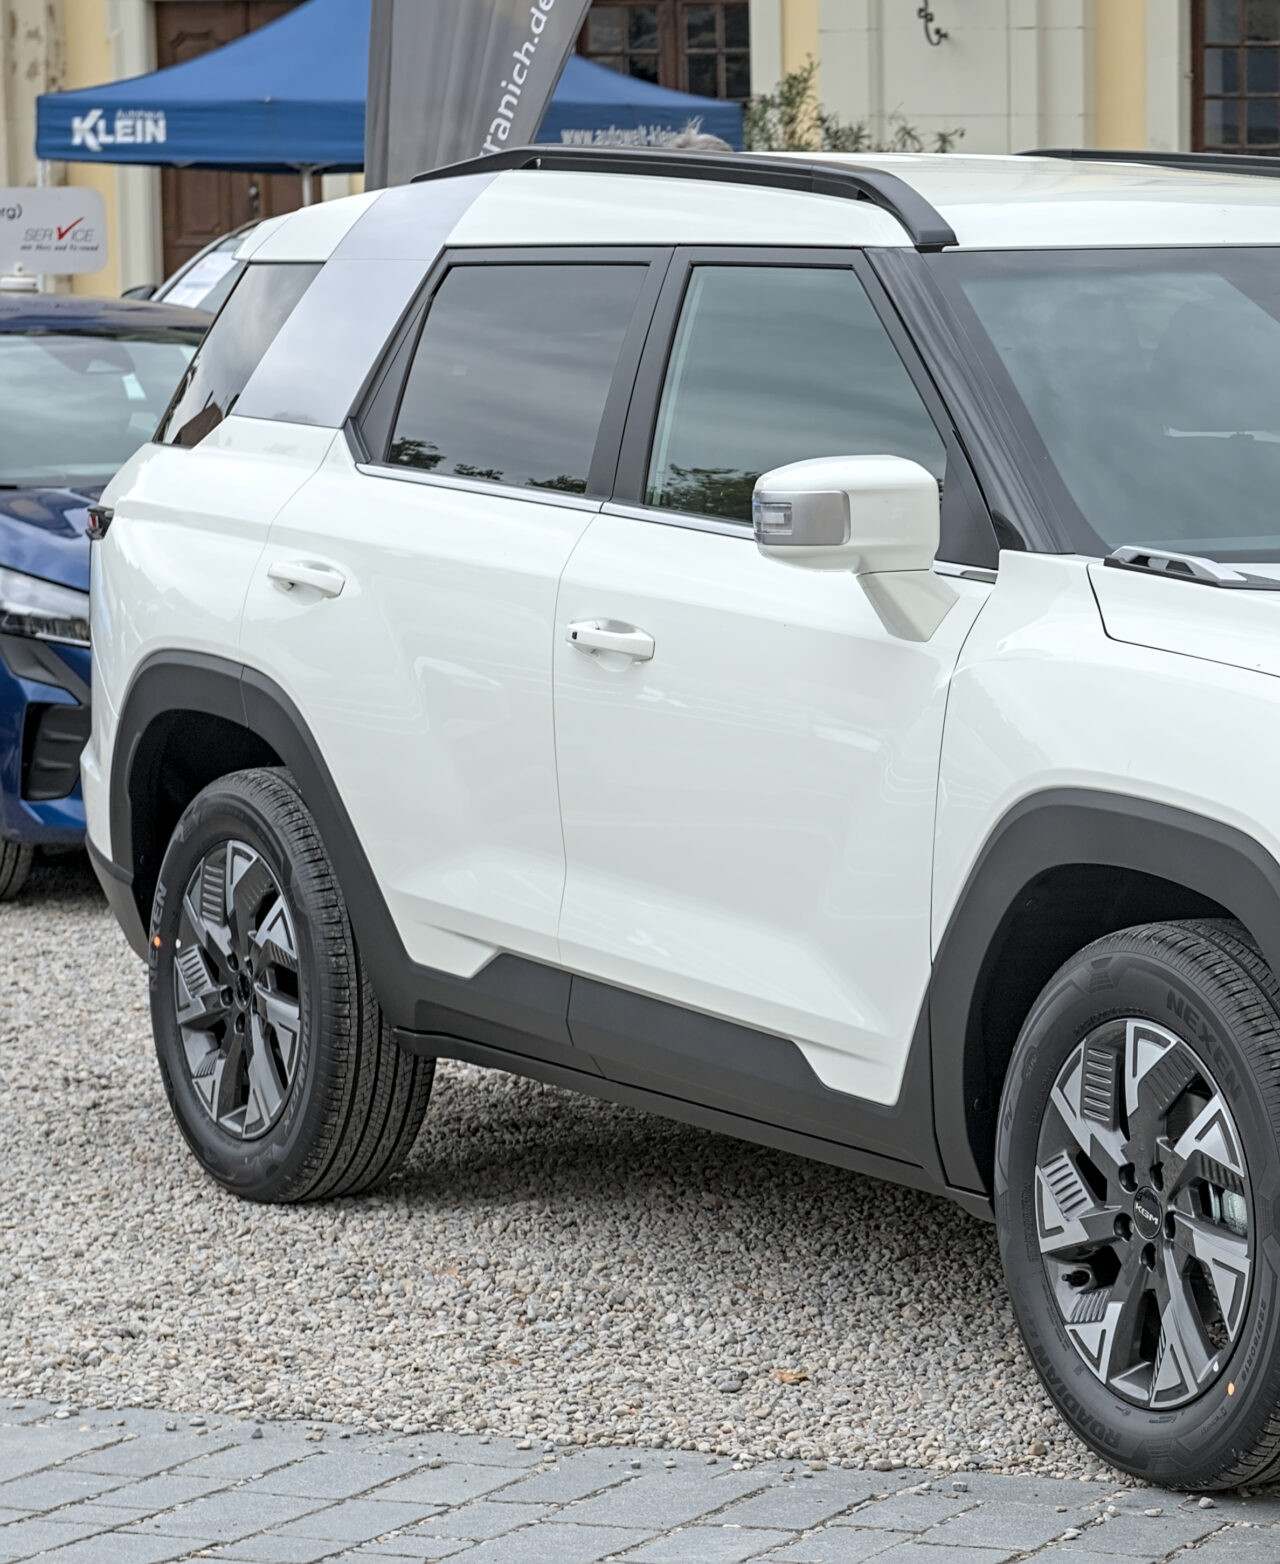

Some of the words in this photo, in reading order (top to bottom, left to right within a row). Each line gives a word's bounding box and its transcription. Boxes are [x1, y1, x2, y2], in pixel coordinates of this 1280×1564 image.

[72, 108, 167, 152] KLEIN
[1166, 988, 1242, 1102] NEXEN
[1135, 1202, 1159, 1225] KGM
